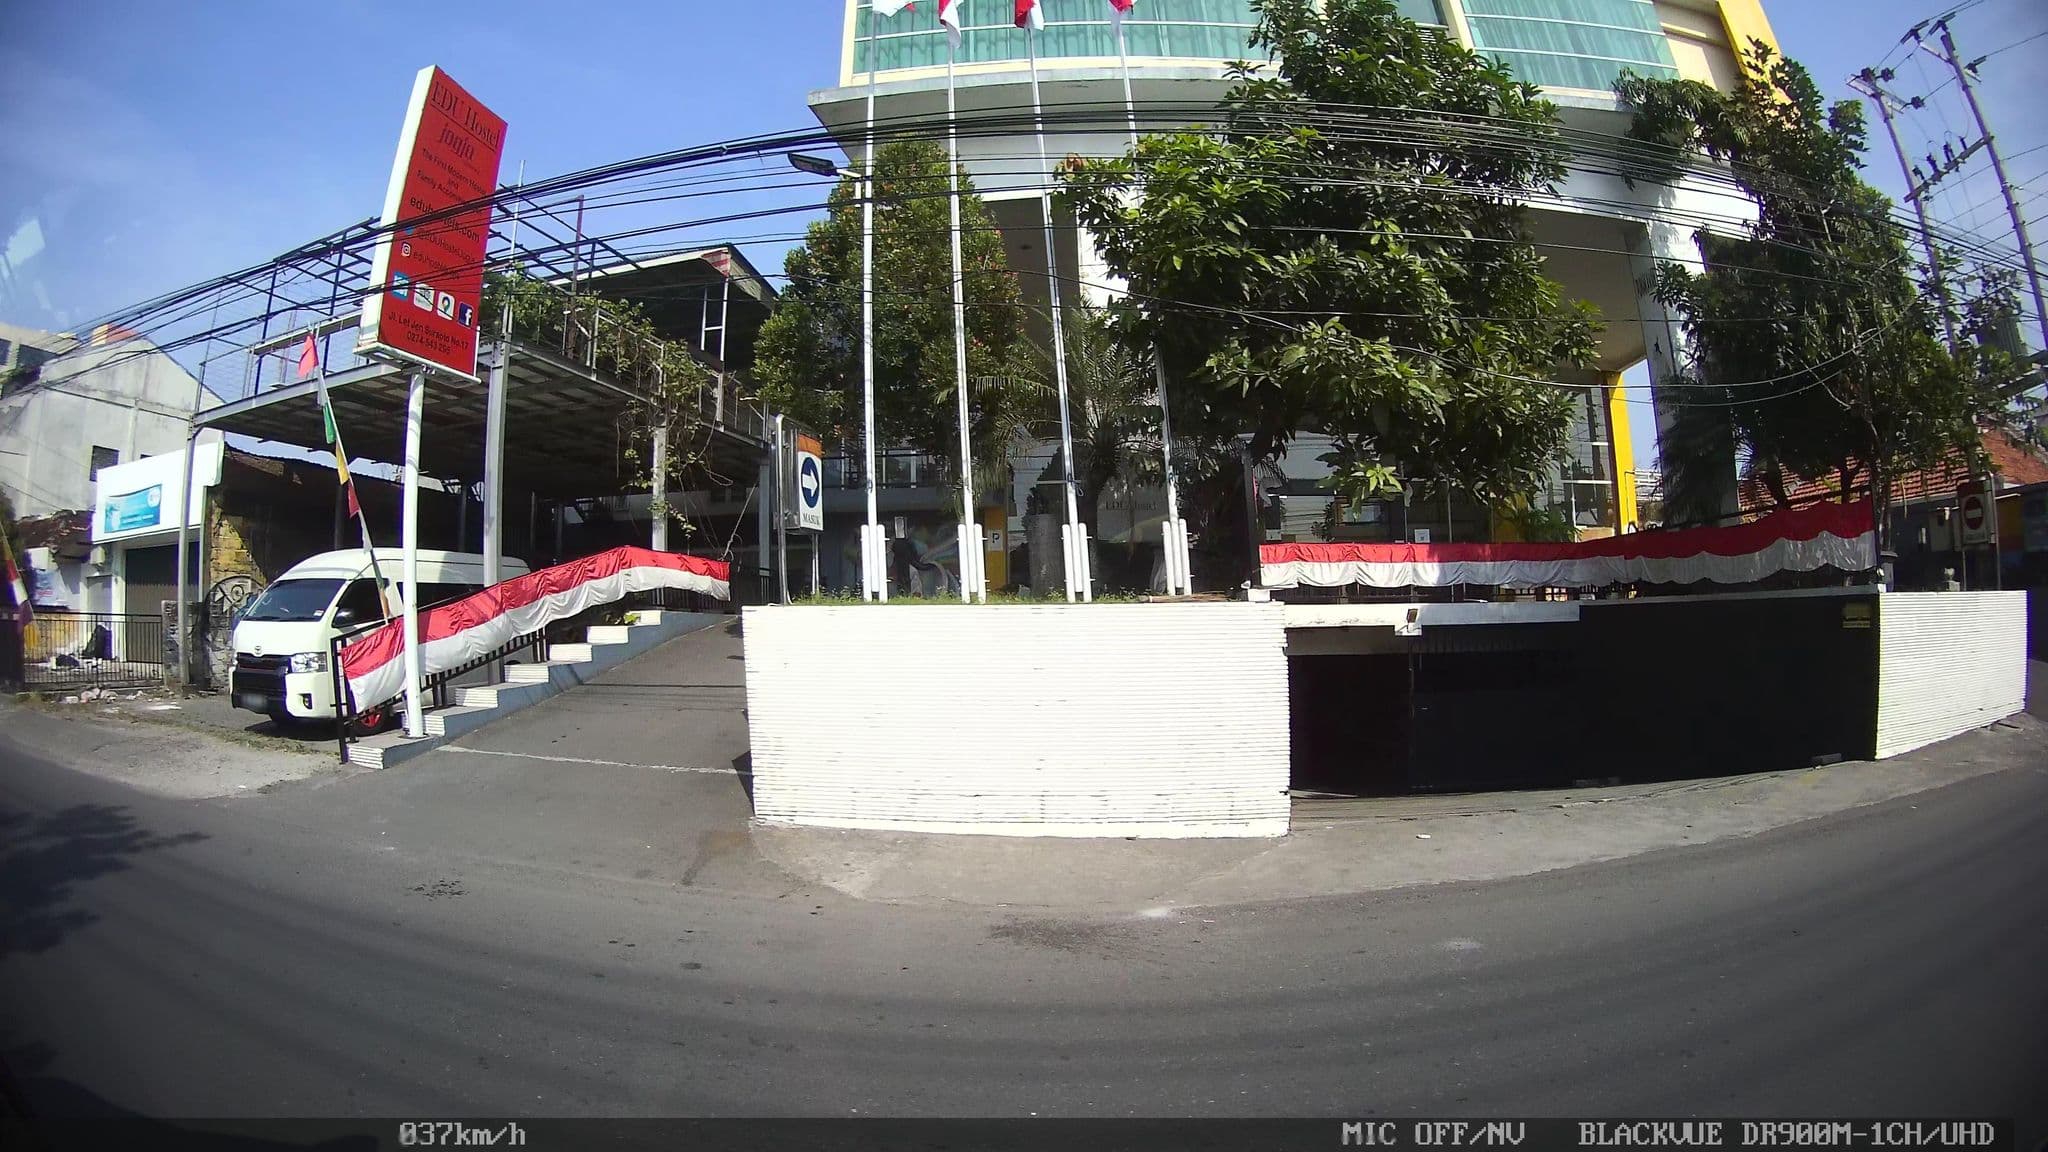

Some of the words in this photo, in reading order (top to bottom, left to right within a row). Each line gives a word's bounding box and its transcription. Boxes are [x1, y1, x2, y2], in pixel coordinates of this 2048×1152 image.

[432, 81, 465, 118] EDU
[464, 106, 501, 148] Hostel
[992, 532, 1000, 544] P
